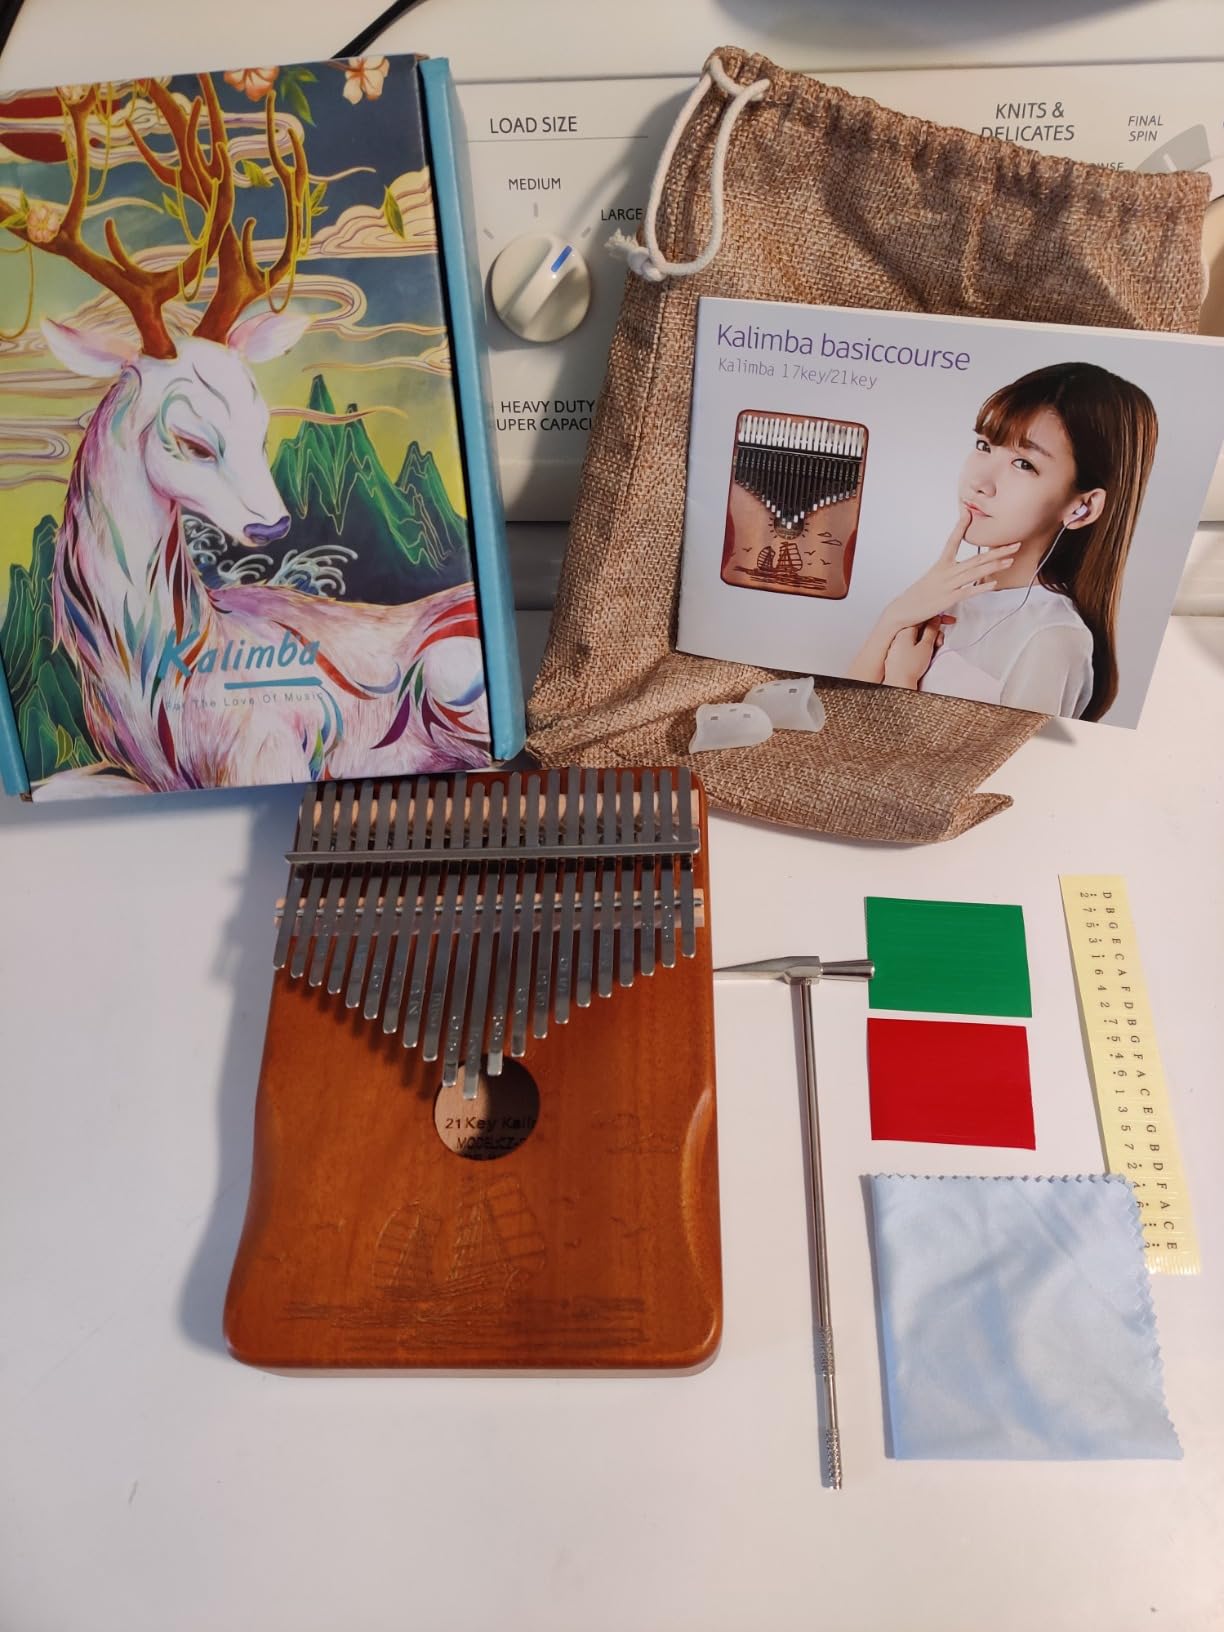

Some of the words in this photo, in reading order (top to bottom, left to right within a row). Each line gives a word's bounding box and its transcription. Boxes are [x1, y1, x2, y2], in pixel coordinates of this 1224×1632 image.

[995, 102, 1047, 120] KNITS
[1051, 101, 1065, 119] &
[489, 116, 537, 134] LOAD
[542, 115, 578, 133] SIZE
[1127, 115, 1164, 127] FINAL
[981, 124, 1076, 142] DELICATES
[1128, 130, 1158, 142] SPIN
[508, 177, 562, 191] MEDIUM
[600, 207, 644, 221] LARGE
[717, 323, 813, 355] Kalimba
[820, 333, 971, 371] basiccourse
[718, 357, 775, 377] Kalimba
[782, 363, 878, 391] 17key/21key
[501, 400, 551, 414] HEAVY
[554, 399, 596, 413] DUTY
[496, 418, 537, 431] UPER
[540, 417, 592, 431] CAPACI
[157, 629, 321, 681] Kalimba
[194, 699, 217, 709] The
[223, 697, 255, 707] Love
[262, 693, 277, 704] Of
[284, 692, 323, 702] Music
[1102, 891, 1113, 899] D
[1108, 921, 1119, 930] G
[1111, 937, 1122, 945] E
[1114, 952, 1125, 961] C
[1117, 968, 1128, 977] A
[1120, 985, 1131, 993] F
[1123, 1001, 1134, 1010] D
[1126, 1018, 1138, 1026] B
[1130, 1035, 1141, 1044] G
[1132, 1053, 1144, 1061] F
[1136, 1069, 1147, 1079] A
[1139, 1087, 1151, 1097] C
[1142, 1106, 1154, 1114] E
[445, 1117, 461, 1129] 21
[465, 1116, 496, 1133] Key
[1145, 1123, 1157, 1133] G
[1148, 1143, 1161, 1152] B
[1152, 1162, 1164, 1172] D
[1156, 1182, 1168, 1190] F
[1159, 1200, 1171, 1210] A
[1163, 1220, 1175, 1231] C
[1166, 1241, 1178, 1250] E
